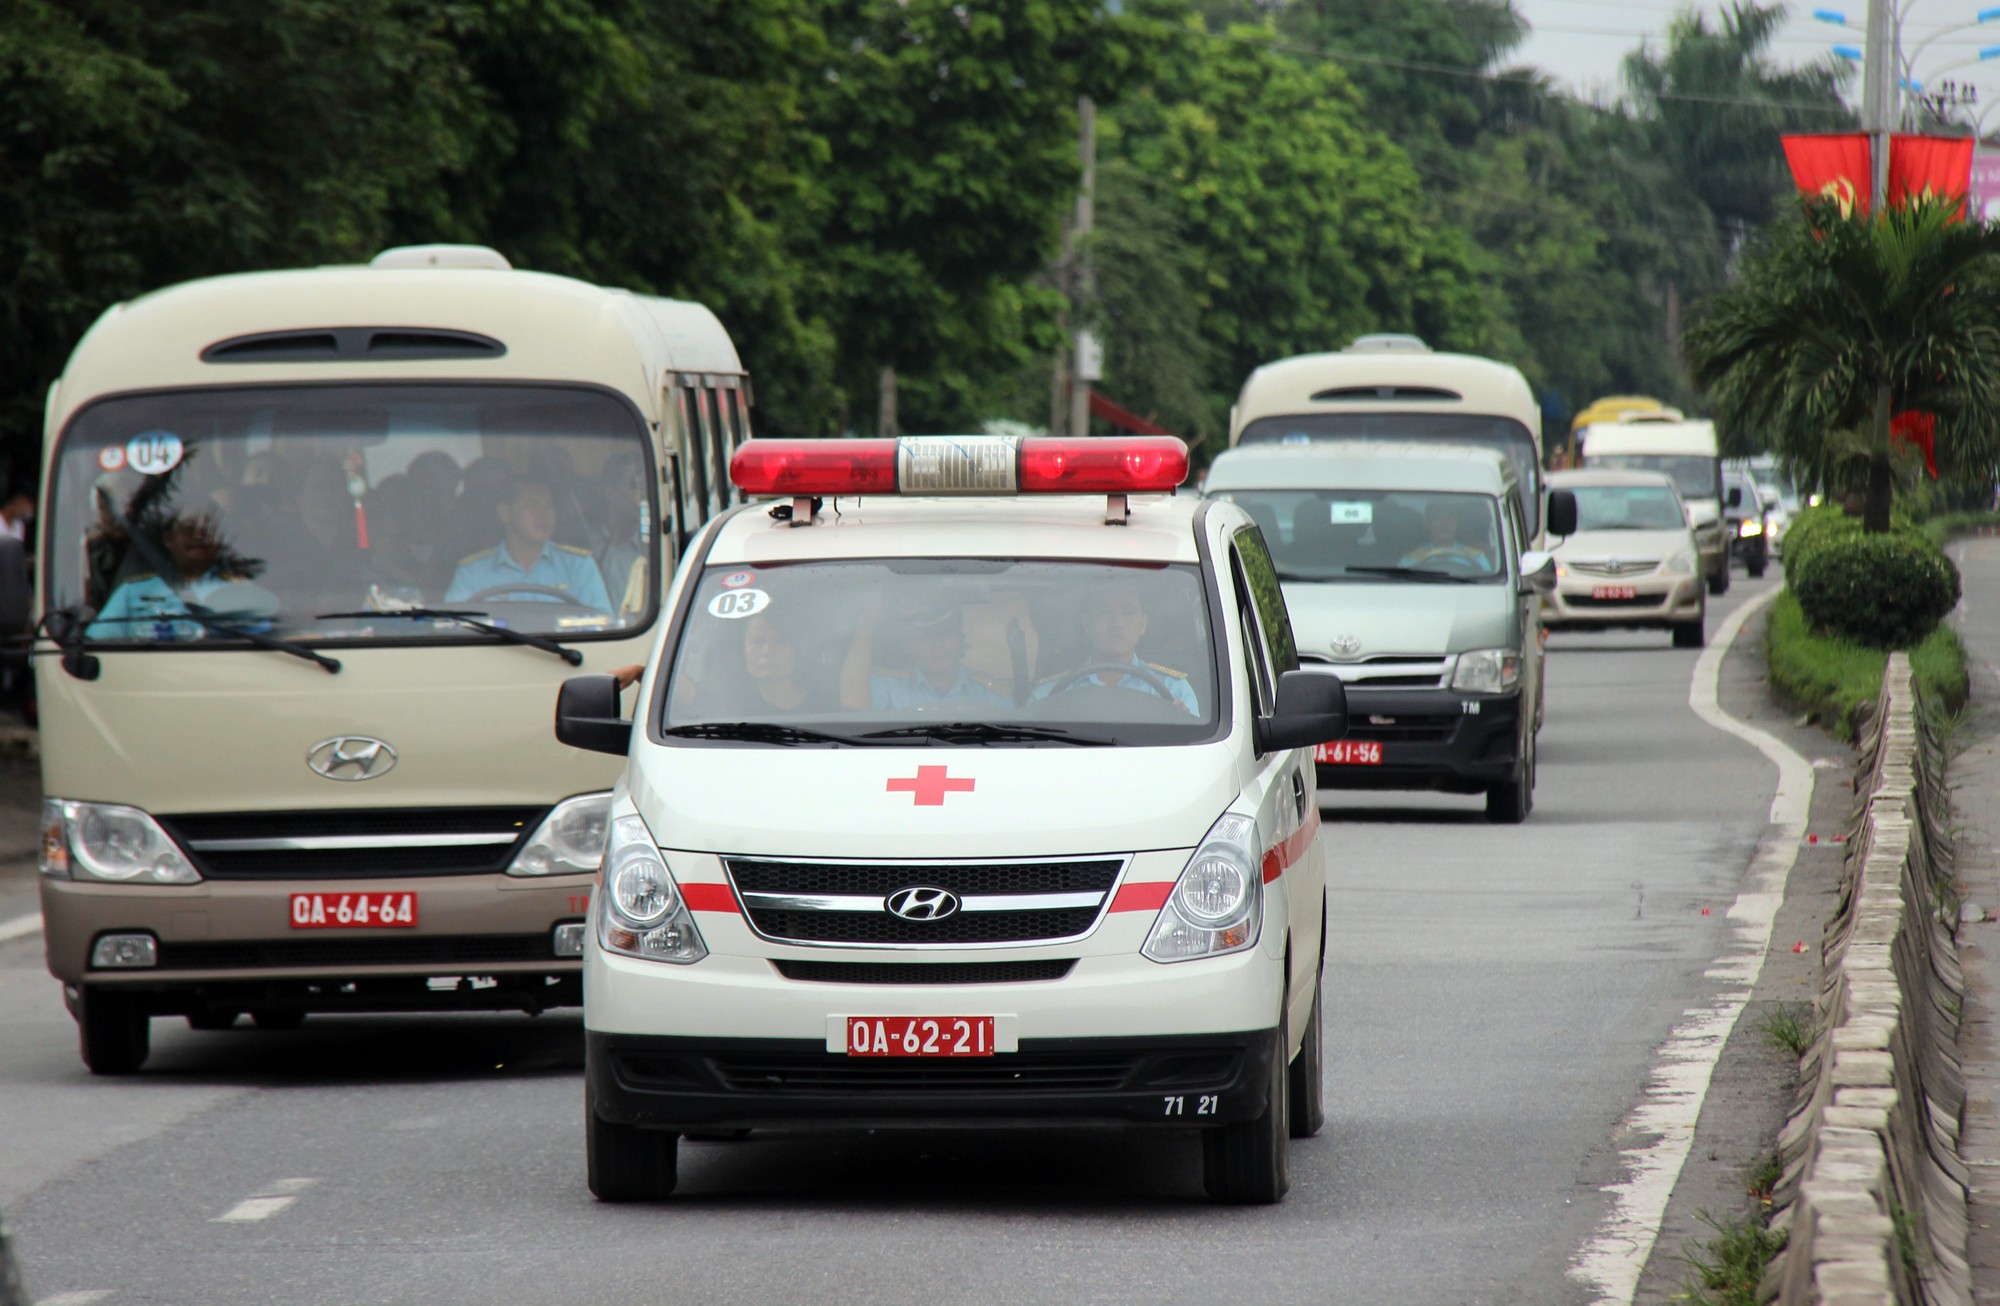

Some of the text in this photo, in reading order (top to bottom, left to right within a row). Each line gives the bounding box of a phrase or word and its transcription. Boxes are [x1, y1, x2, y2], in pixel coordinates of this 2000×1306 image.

[717, 592, 757, 615] 03
[1461, 701, 1480, 714] TM
[853, 1020, 985, 1053] QA-62-21
[1164, 1095, 1218, 1116] 71 21
